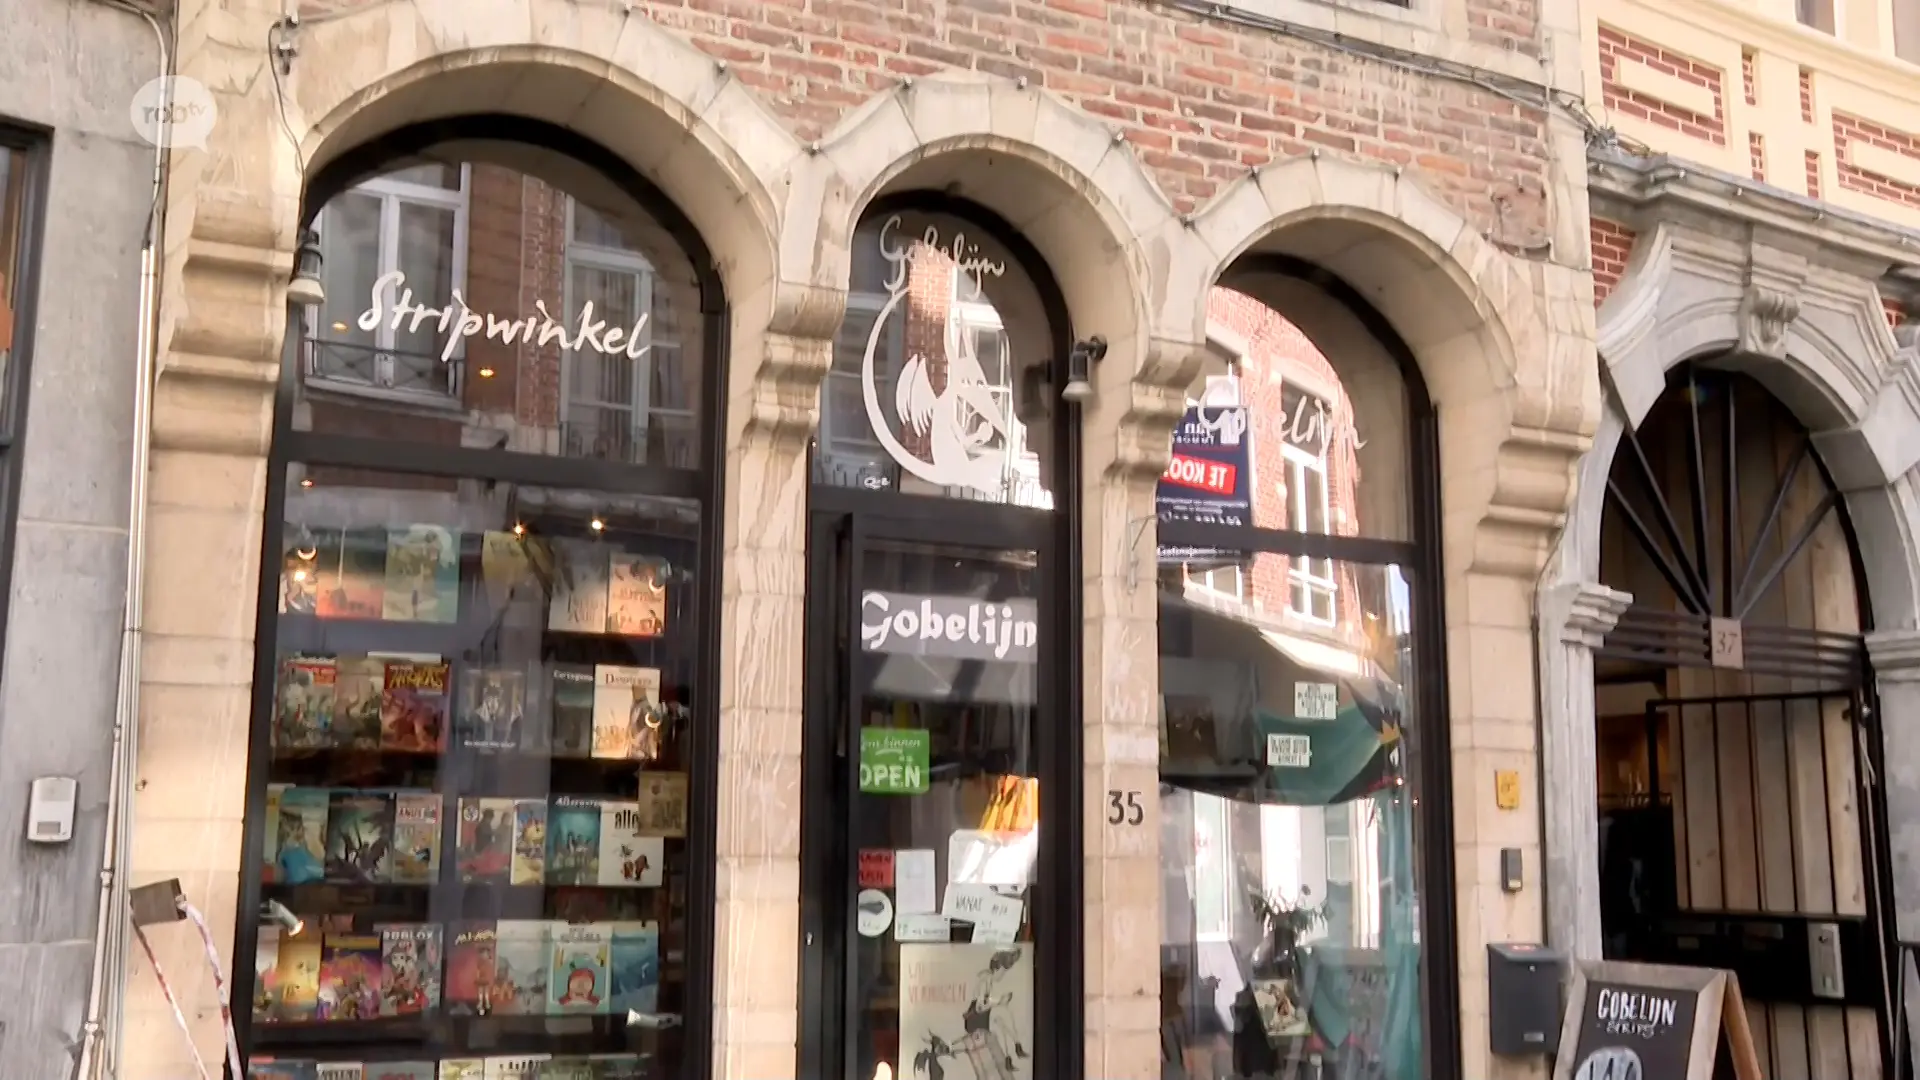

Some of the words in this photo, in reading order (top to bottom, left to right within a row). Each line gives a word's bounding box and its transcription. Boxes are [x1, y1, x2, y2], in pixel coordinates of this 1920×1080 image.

[880, 215, 1006, 299] Gobelijn
[357, 271, 649, 361] Stripwinkel
[861, 591, 1037, 659] Gobelijn
[1715, 631, 1738, 655] 37
[859, 762, 921, 788] OPEN
[1108, 789, 1144, 826] 35
[1598, 988, 1676, 1027] GOBELIJN
